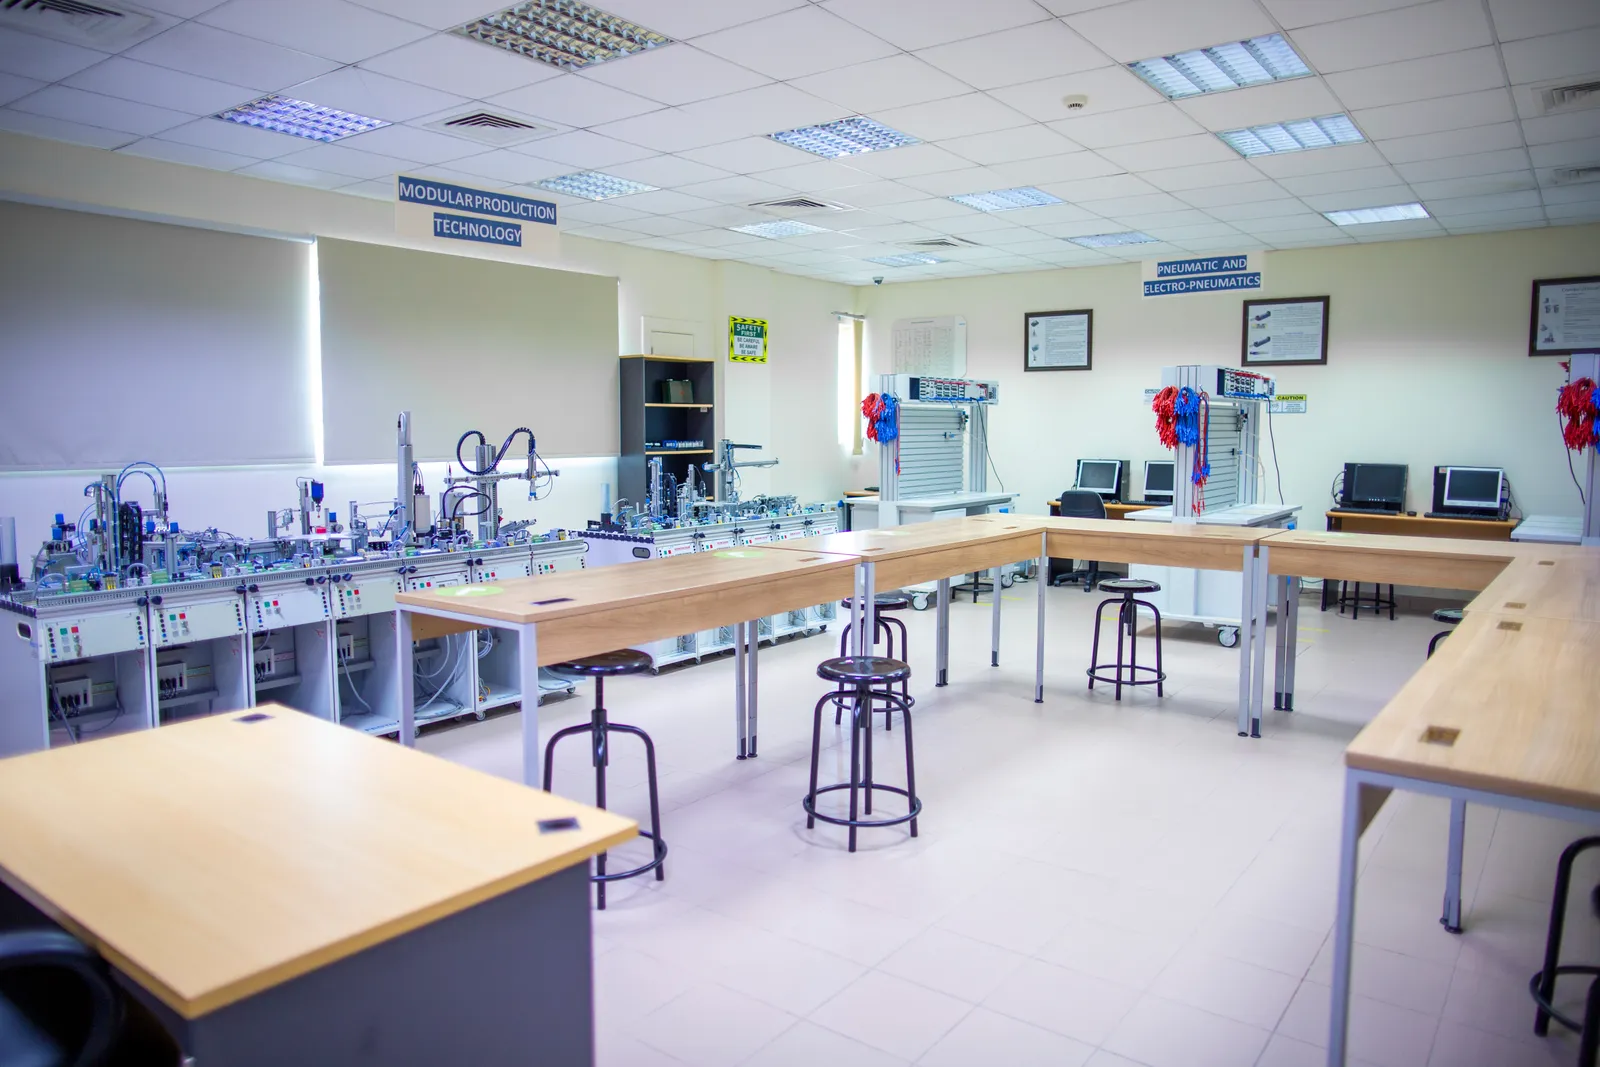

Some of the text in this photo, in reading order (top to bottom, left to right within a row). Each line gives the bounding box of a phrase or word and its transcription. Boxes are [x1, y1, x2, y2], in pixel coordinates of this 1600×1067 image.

[399, 182, 555, 220] MODULAR PRODUCTION
[433, 218, 522, 243] TECHNOLOGY
[1157, 258, 1247, 275] PNEUMATIC AND
[1144, 275, 1261, 294] ELECTRO-PNEUMATICS
[736, 323, 762, 333] SAFETY
